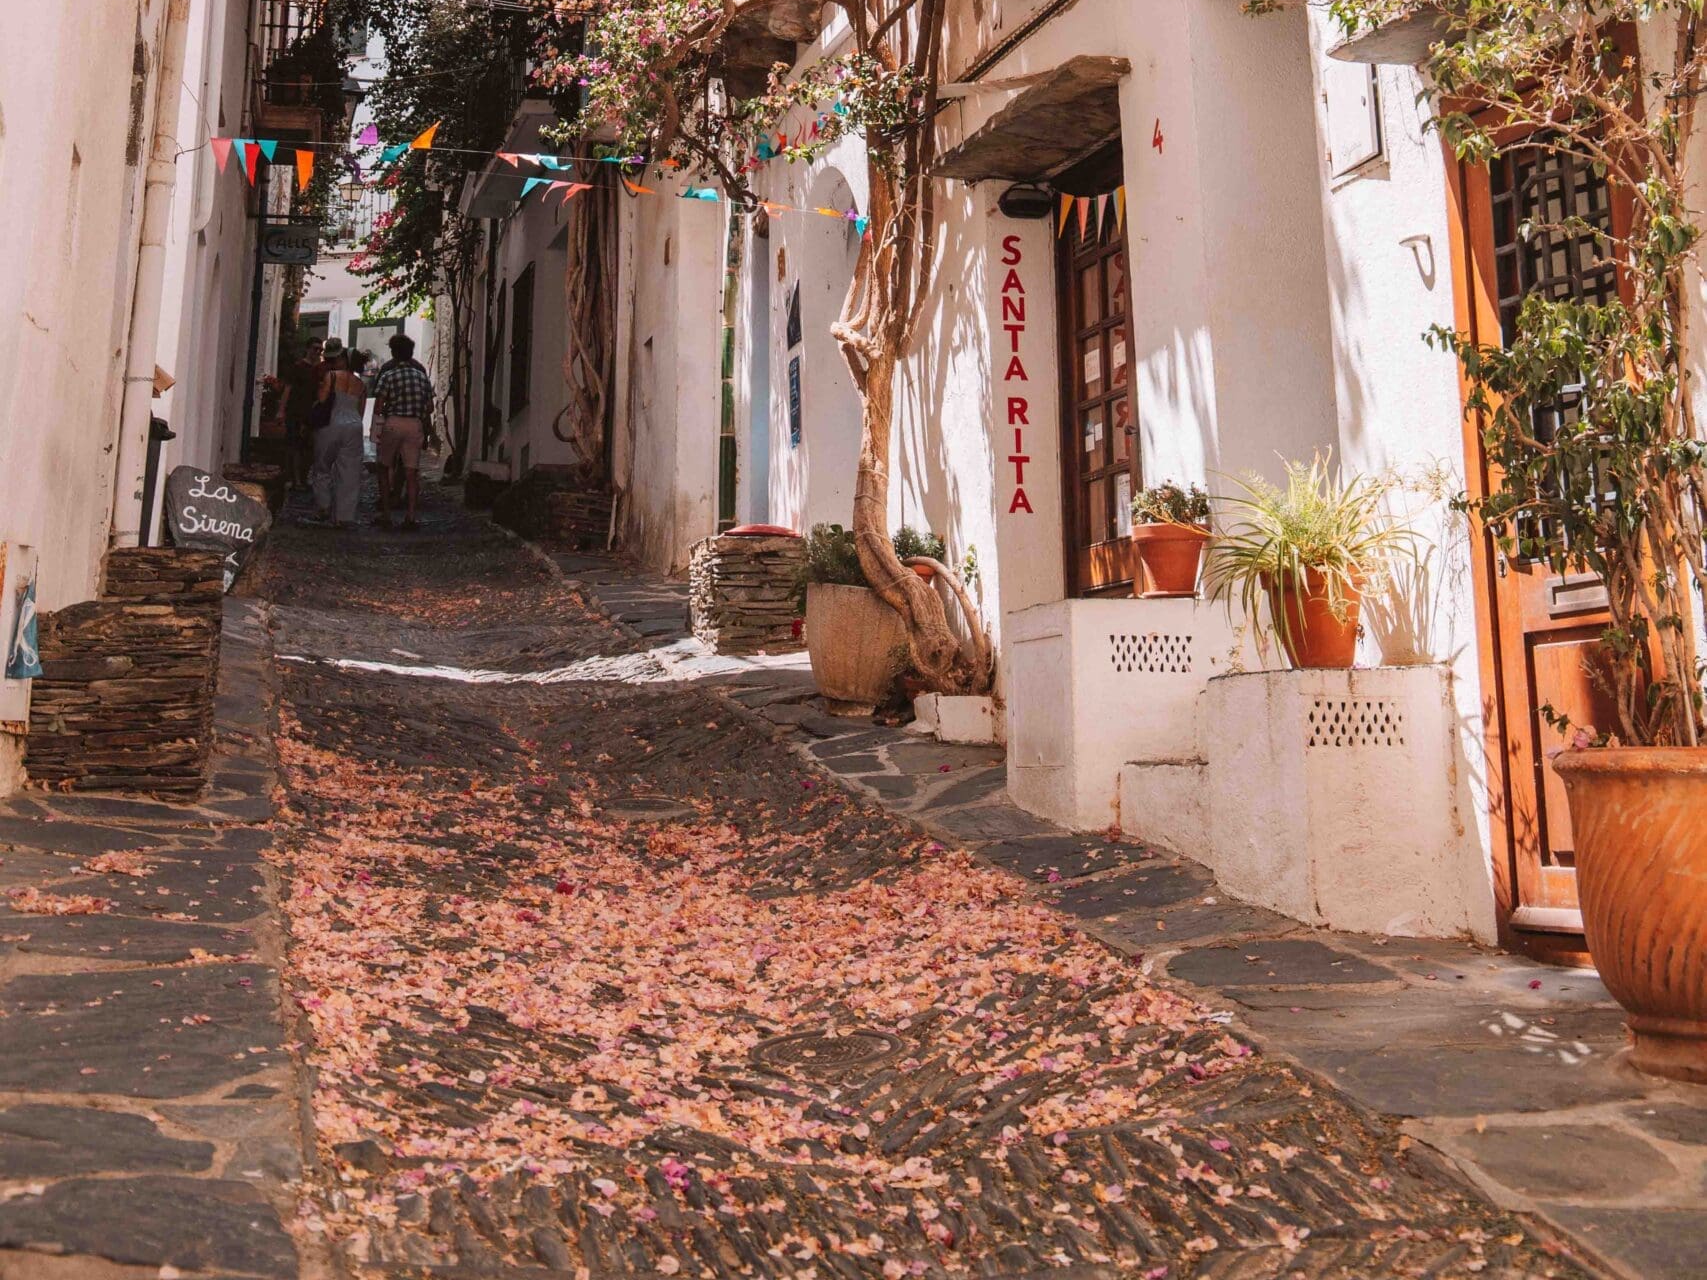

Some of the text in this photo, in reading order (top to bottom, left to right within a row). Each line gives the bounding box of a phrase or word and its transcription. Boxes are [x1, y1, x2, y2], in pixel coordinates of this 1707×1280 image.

[1152, 117, 1164, 155] 4
[1001, 235, 1034, 514] SANTA RITA
[188, 475, 237, 503] La
[179, 506, 254, 543] Sirena
